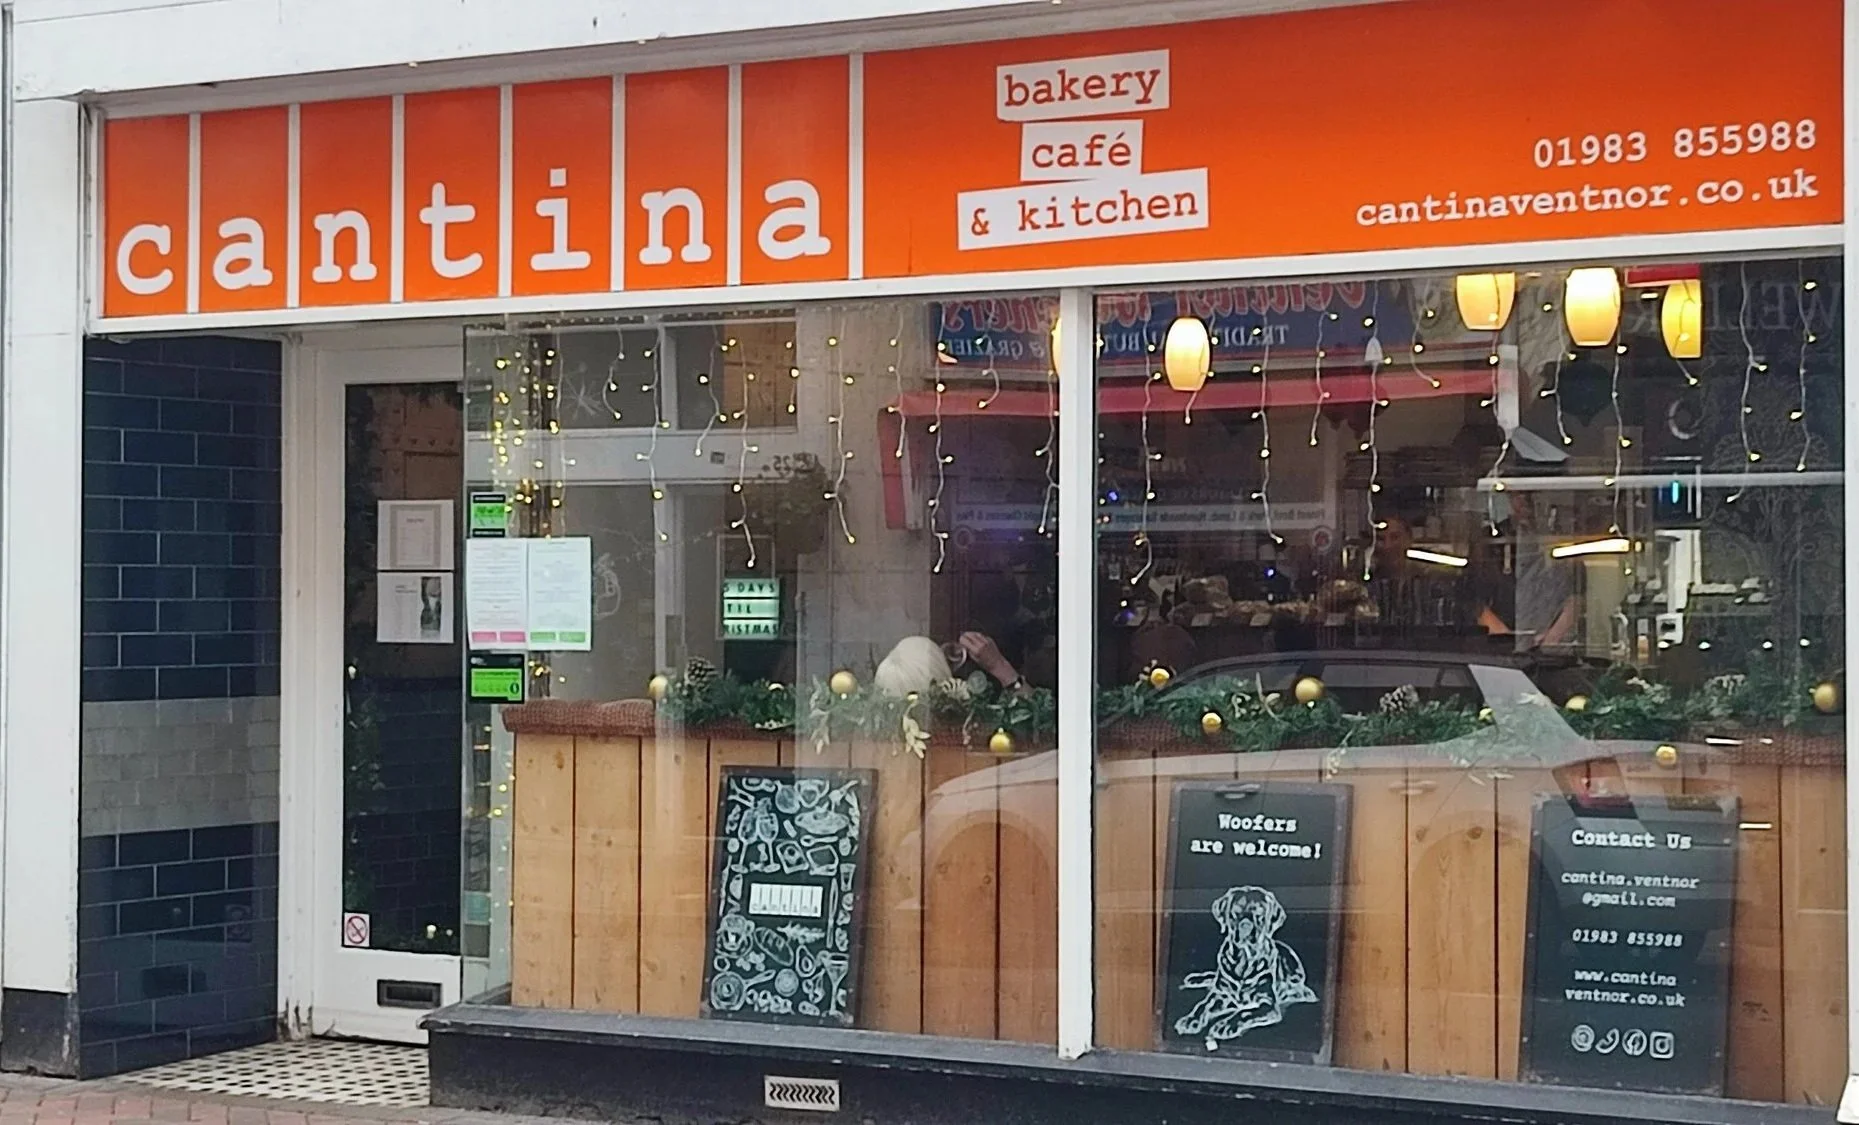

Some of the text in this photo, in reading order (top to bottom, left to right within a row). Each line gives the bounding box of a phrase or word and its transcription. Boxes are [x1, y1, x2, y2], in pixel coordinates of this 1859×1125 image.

[1003, 62, 1160, 106] bakery
[1031, 133, 1132, 169] café
[1534, 119, 1817, 168] 01983 855988
[1356, 168, 1819, 227] cantinaventnor.co.uk
[970, 185, 1200, 237] & kitchen
[116, 168, 831, 295] cantina
[737, 582, 775, 593] DAYS
[727, 603, 752, 614] TIL
[1218, 813, 1297, 833] Woofers
[1190, 838, 1322, 860] are welcome!
[1571, 828, 1692, 850] Contact Us
[1560, 870, 1700, 889] cantina.ventnor
[1581, 890, 1676, 908] @gmail.com
[1572, 928, 1683, 948] 01983 855988
[1574, 969, 1677, 987] www.cantina
[1564, 988, 1686, 1008] ventnor.co.uk
